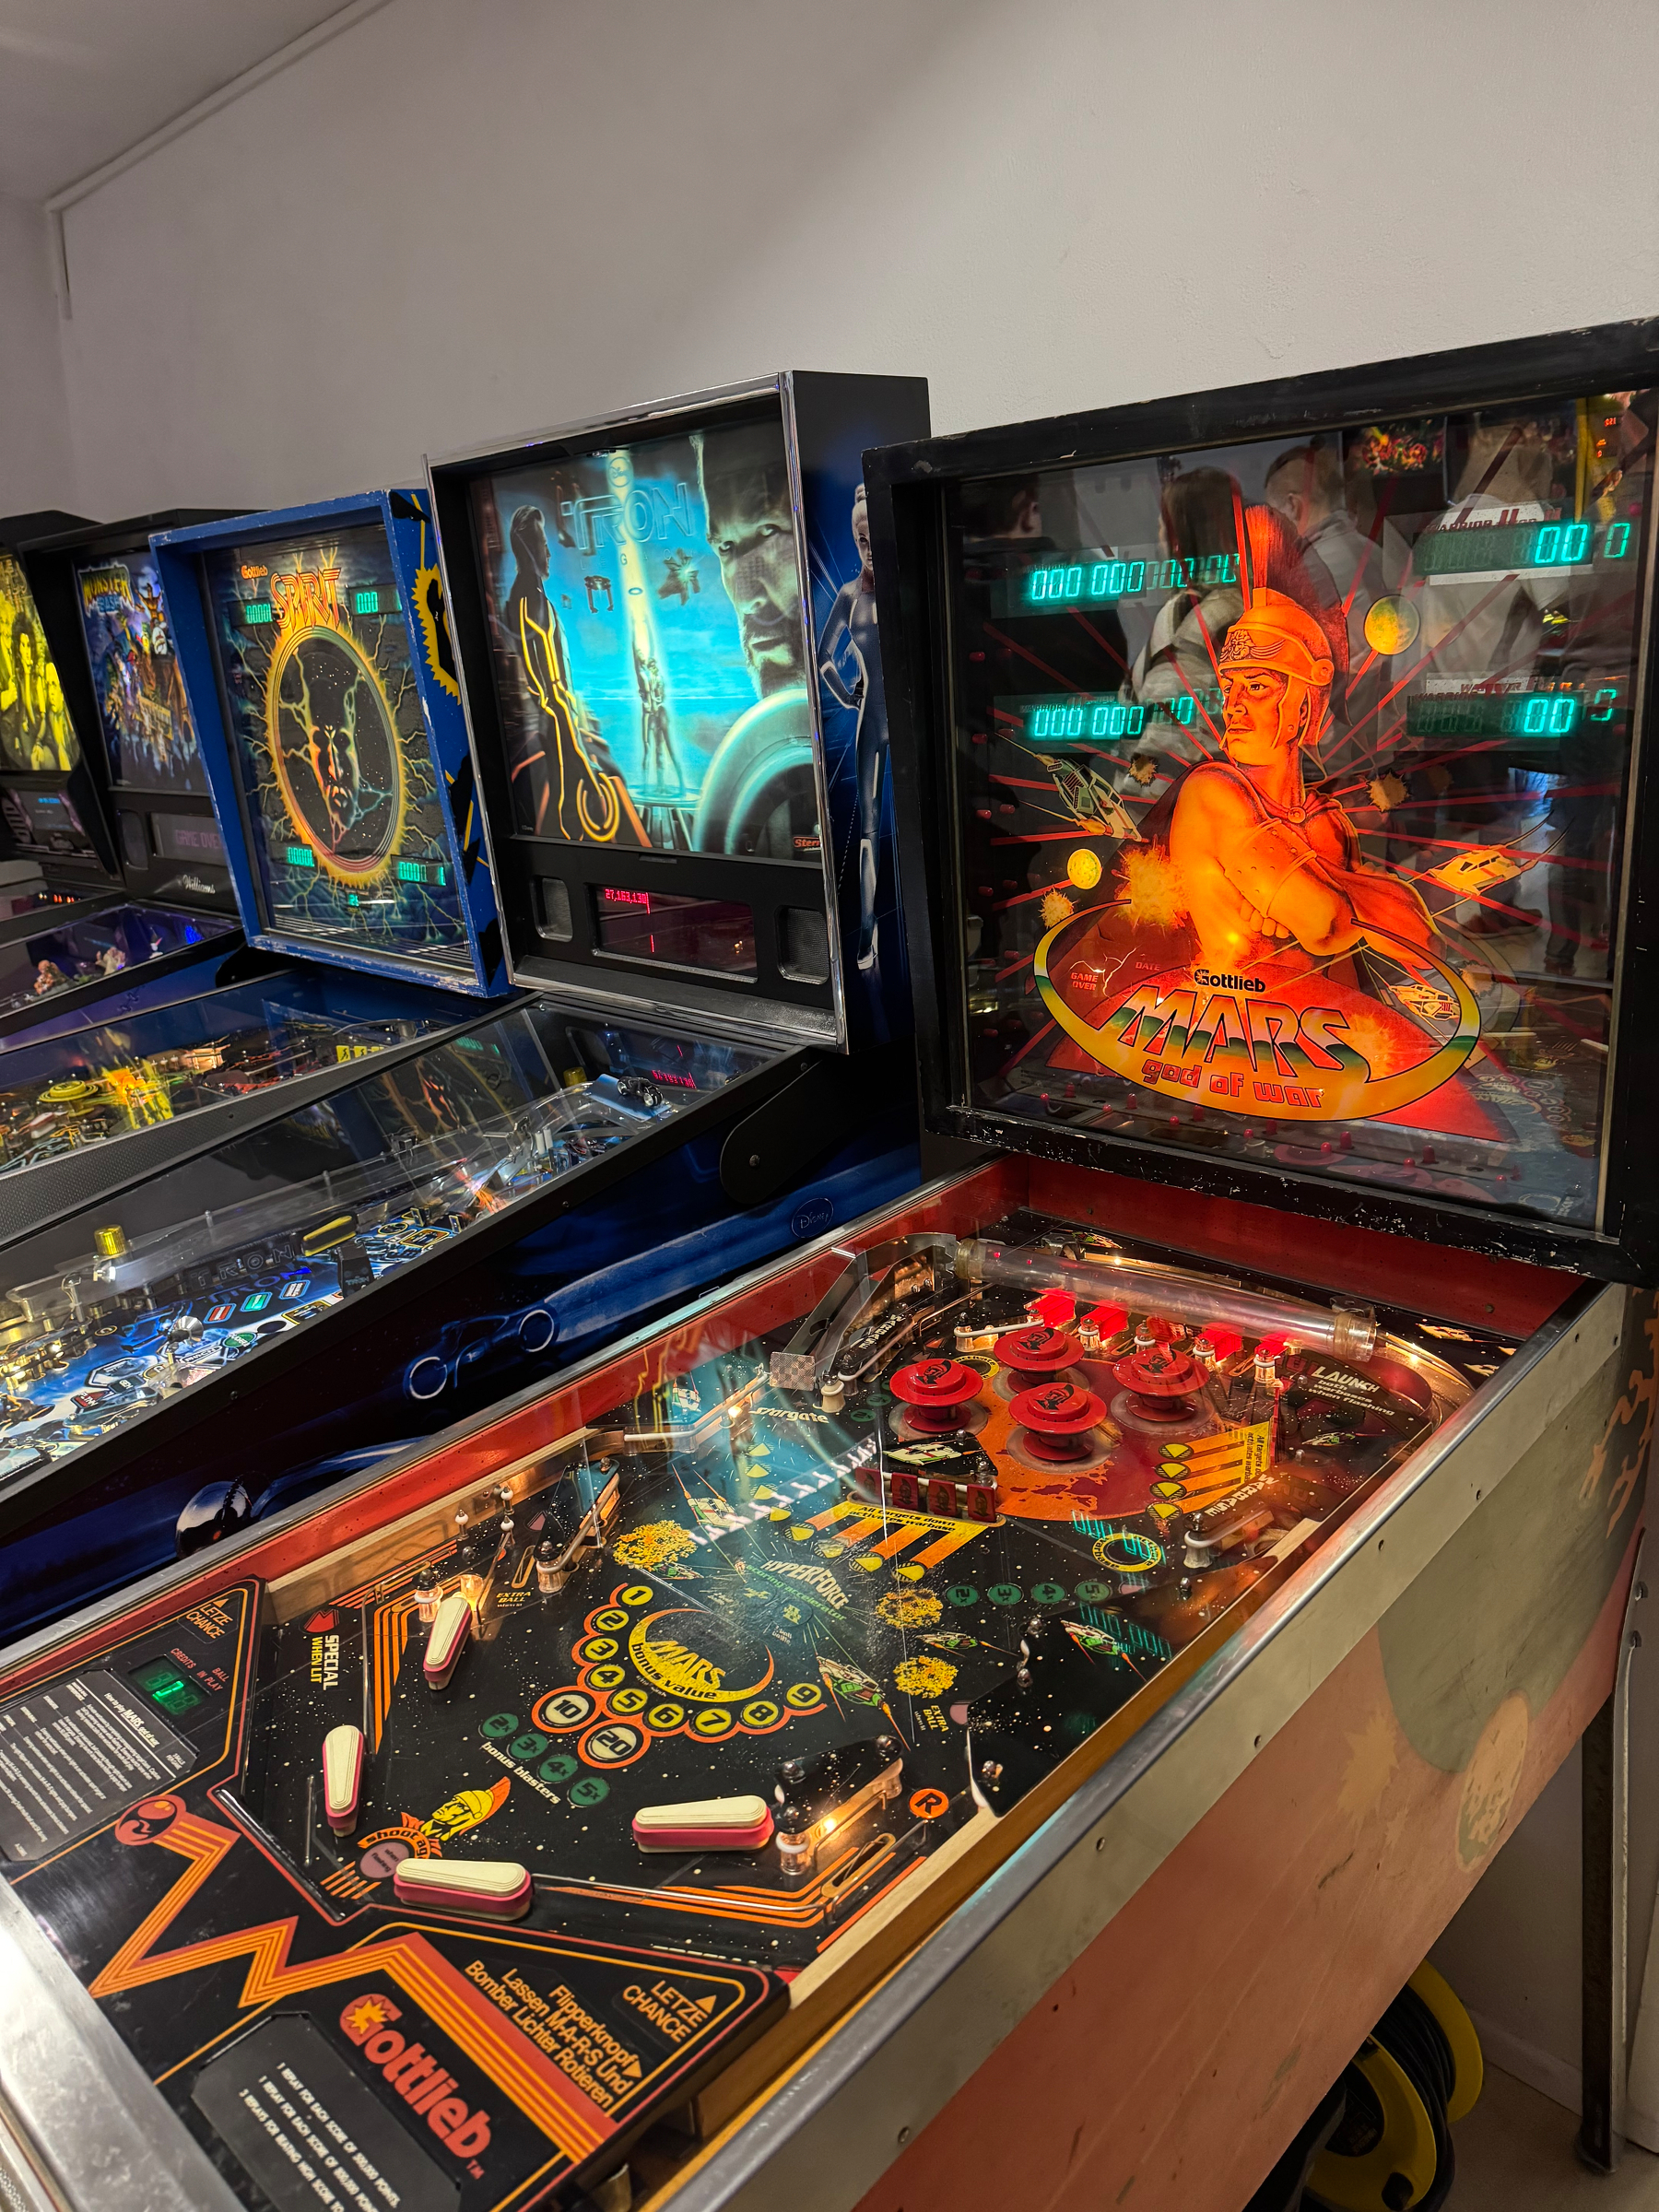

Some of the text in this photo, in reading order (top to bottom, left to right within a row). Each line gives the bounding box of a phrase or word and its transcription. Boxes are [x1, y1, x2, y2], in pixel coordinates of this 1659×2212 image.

[560, 482, 693, 550] TRON
[241, 565, 268, 580] Gottlieb
[270, 567, 342, 629] SPIRIT
[175, 830, 199, 847] GAME
[183, 875, 216, 895] Williams
[1070, 972, 1099, 983] GAME
[1135, 961, 1160, 971] DATE
[1072, 981, 1097, 992] OVER
[1194, 969, 1266, 994] Gottlieb
[1098, 984, 1371, 1084] MARS
[1142, 1059, 1325, 1108] god of war
[1311, 1366, 1381, 1393] LAUNCH
[1317, 1380, 1348, 1391] both
[1308, 1388, 1395, 1416] when flashing
[1313, 1383, 1373, 1403] warbases
[748, 1406, 830, 1424] Stargate
[1204, 1474, 1280, 1517] WARBASE
[877, 1509, 922, 1521] targets
[924, 1517, 956, 1527] down
[905, 1520, 957, 1532] warbase
[629, 1589, 645, 1601] 1
[747, 1564, 785, 1589] scoring
[784, 1586, 847, 1620] accelerator
[760, 1559, 849, 1610] HYPERFORCE
[186, 1611, 225, 1639] CHANCE
[200, 1604, 233, 1626] LETZE
[603, 1612, 625, 1628] 2
[171, 1648, 196, 1669] CREDITS
[593, 1640, 612, 1656] 3
[311, 1636, 324, 1684] WHEN LIT
[323, 1635, 339, 1691] SPECIAL
[631, 1641, 664, 1680] bonus
[665, 1680, 717, 1700] value
[645, 1640, 726, 1690] MARS
[196, 1670, 223, 1691] IN PLAY
[212, 1667, 229, 1683] BALL
[598, 1668, 616, 1685] 4
[553, 1698, 582, 1720] 10
[619, 1693, 641, 1711] 5
[748, 1704, 772, 1721] 8
[655, 1705, 679, 1724] 6
[701, 1712, 726, 1731] 7
[923, 1709, 938, 1731] BALL
[931, 1705, 949, 1732] EXTRA
[596, 1729, 630, 1756] 20
[481, 1741, 561, 1805] bonus blasters
[914, 1793, 942, 1814] R
[366, 1830, 420, 1844] shoot
[623, 1984, 692, 2043] CHANCE
[650, 1981, 708, 2028] LETZE
[465, 1959, 614, 2109] Bomber Lichter Rotieren
[501, 1968, 634, 2095] Lassen M-A-R-S Und
[548, 1984, 638, 2068] Flipperknopf
[339, 1993, 491, 2181] Gottlieb TM
[281, 2067, 304, 2091] REPLAY
[298, 2088, 315, 2105] FOR
[310, 2101, 331, 2123] EACH
[324, 2120, 348, 2144] SCORE
[343, 2141, 359, 2154] OF
[262, 2081, 286, 2104] REPLAY
[280, 2102, 297, 2119] FOR
[290, 2115, 312, 2137] EACH
[306, 2134, 330, 2159] SCORE
[324, 2155, 339, 2168] OF
[244, 2094, 270, 2122] REPLAYS
[264, 2119, 280, 2136] FOR
[275, 2133, 302, 2163] BEATING
[297, 2160, 317, 2182] HIGH
[312, 2178, 335, 2205] SCORE
